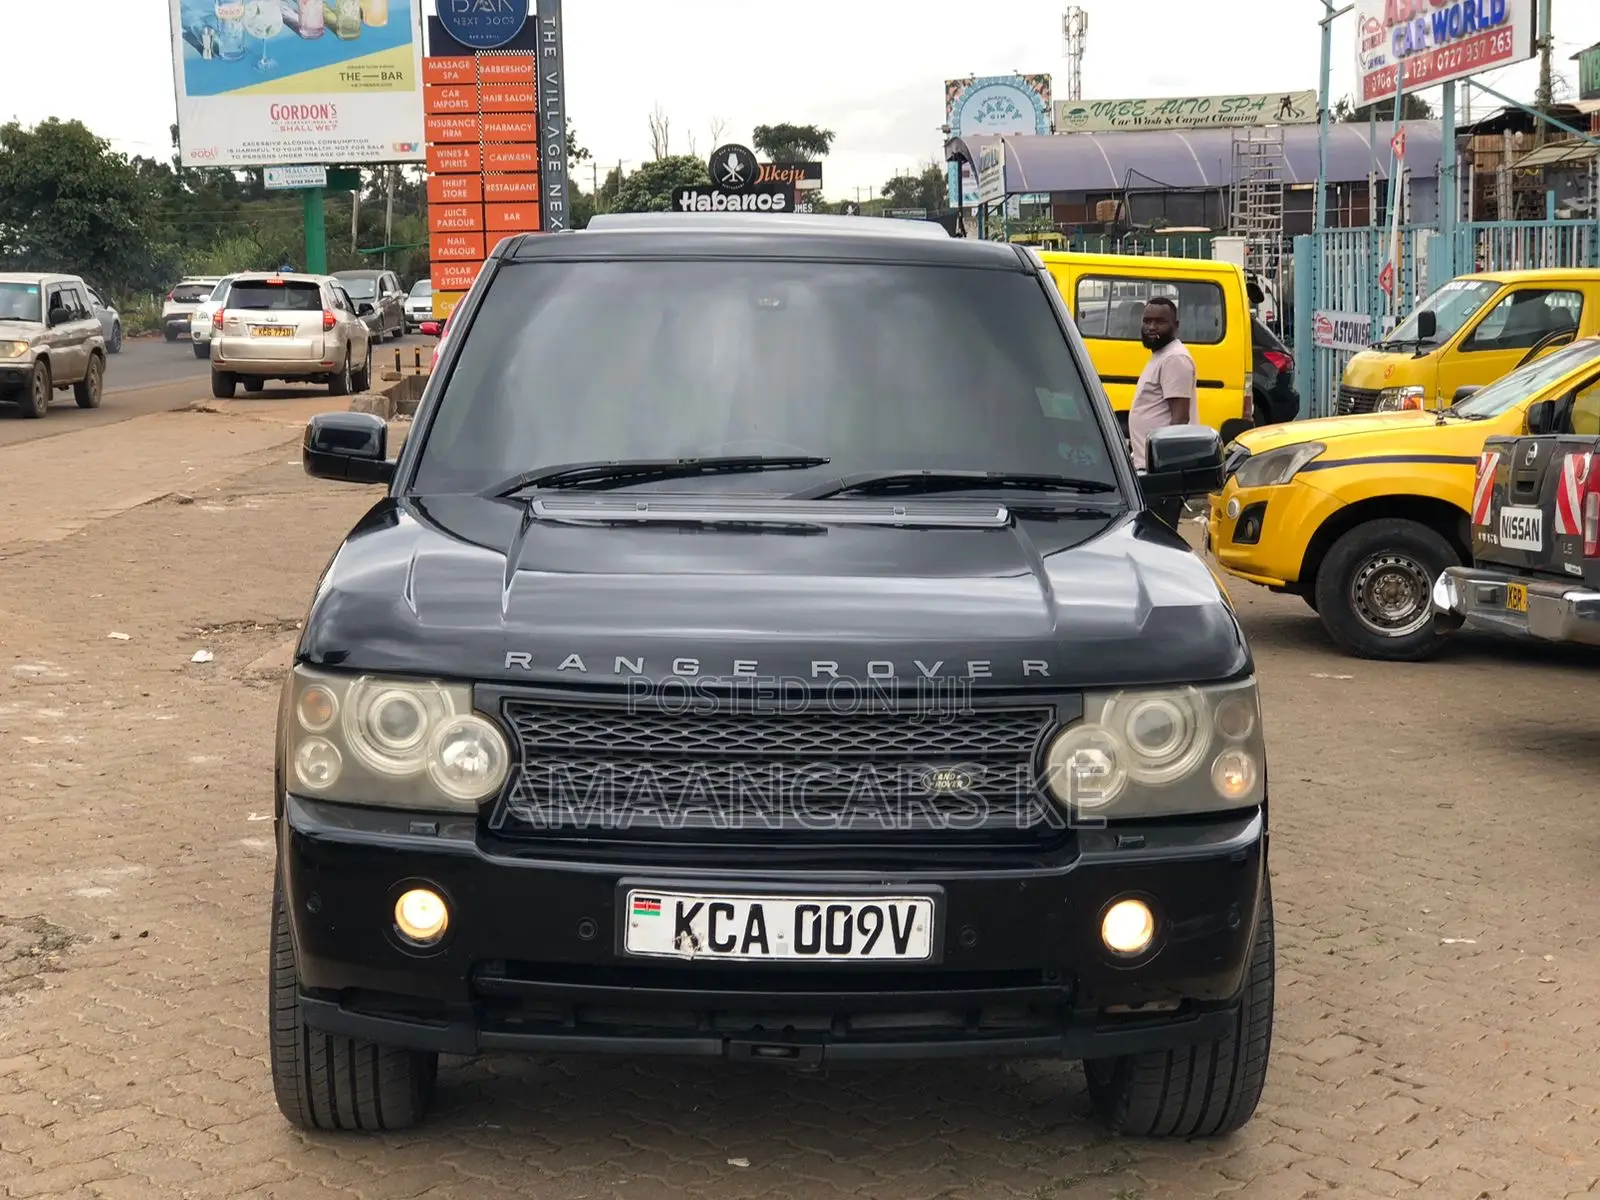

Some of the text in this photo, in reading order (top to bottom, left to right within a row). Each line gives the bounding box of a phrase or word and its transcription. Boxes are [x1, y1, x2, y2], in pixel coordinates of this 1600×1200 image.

[1392, 17, 1427, 58] CAR
[1431, 0, 1506, 44] WORLD
[543, 16, 557, 58] THE
[1436, 47, 1463, 72] 0727
[1466, 40, 1486, 62] 937
[1490, 30, 1512, 56] 263
[428, 61, 470, 69] MASSAGE
[480, 65, 532, 73] BARBERSHOP
[339, 71, 404, 81] THE BAR
[443, 71, 459, 79] SPA
[441, 90, 460, 98] CAR
[504, 94, 533, 102] SALON
[433, 100, 469, 108] IMPORTS
[1090, 95, 1268, 121] VYBE AUTO SPA
[270, 101, 337, 120] GORDON'S
[427, 119, 476, 128] INSURANCE
[545, 71, 562, 171] VILLAGE
[1111, 117, 1131, 126] Car
[1133, 116, 1162, 126] Wash
[1175, 115, 1210, 126] Carpet
[1211, 113, 1258, 124] Cleaning
[484, 123, 532, 132] PHARMACY
[442, 129, 462, 138] FIRM
[436, 149, 470, 157] WINES &
[489, 153, 532, 161] CARWASH
[439, 159, 468, 168] SPIRITS
[442, 179, 467, 187] THRIFT
[485, 183, 537, 192] RESTAURANT
[442, 189, 468, 198] STORE
[679, 190, 786, 212] Habanos
[443, 208, 467, 217] JUICE
[503, 213, 521, 221] BAR
[437, 219, 475, 227] PARLOUR
[446, 237, 466, 245] NAIL
[438, 247, 476, 256] PARLOUR
[444, 267, 471, 275] SOLAR
[1501, 515, 1540, 542] NISSAN
[504, 651, 1050, 678] RANGE ROVER
[932, 772, 956, 781] LAND
[934, 780, 963, 789] ROVER
[673, 901, 917, 955] KCA 009V
